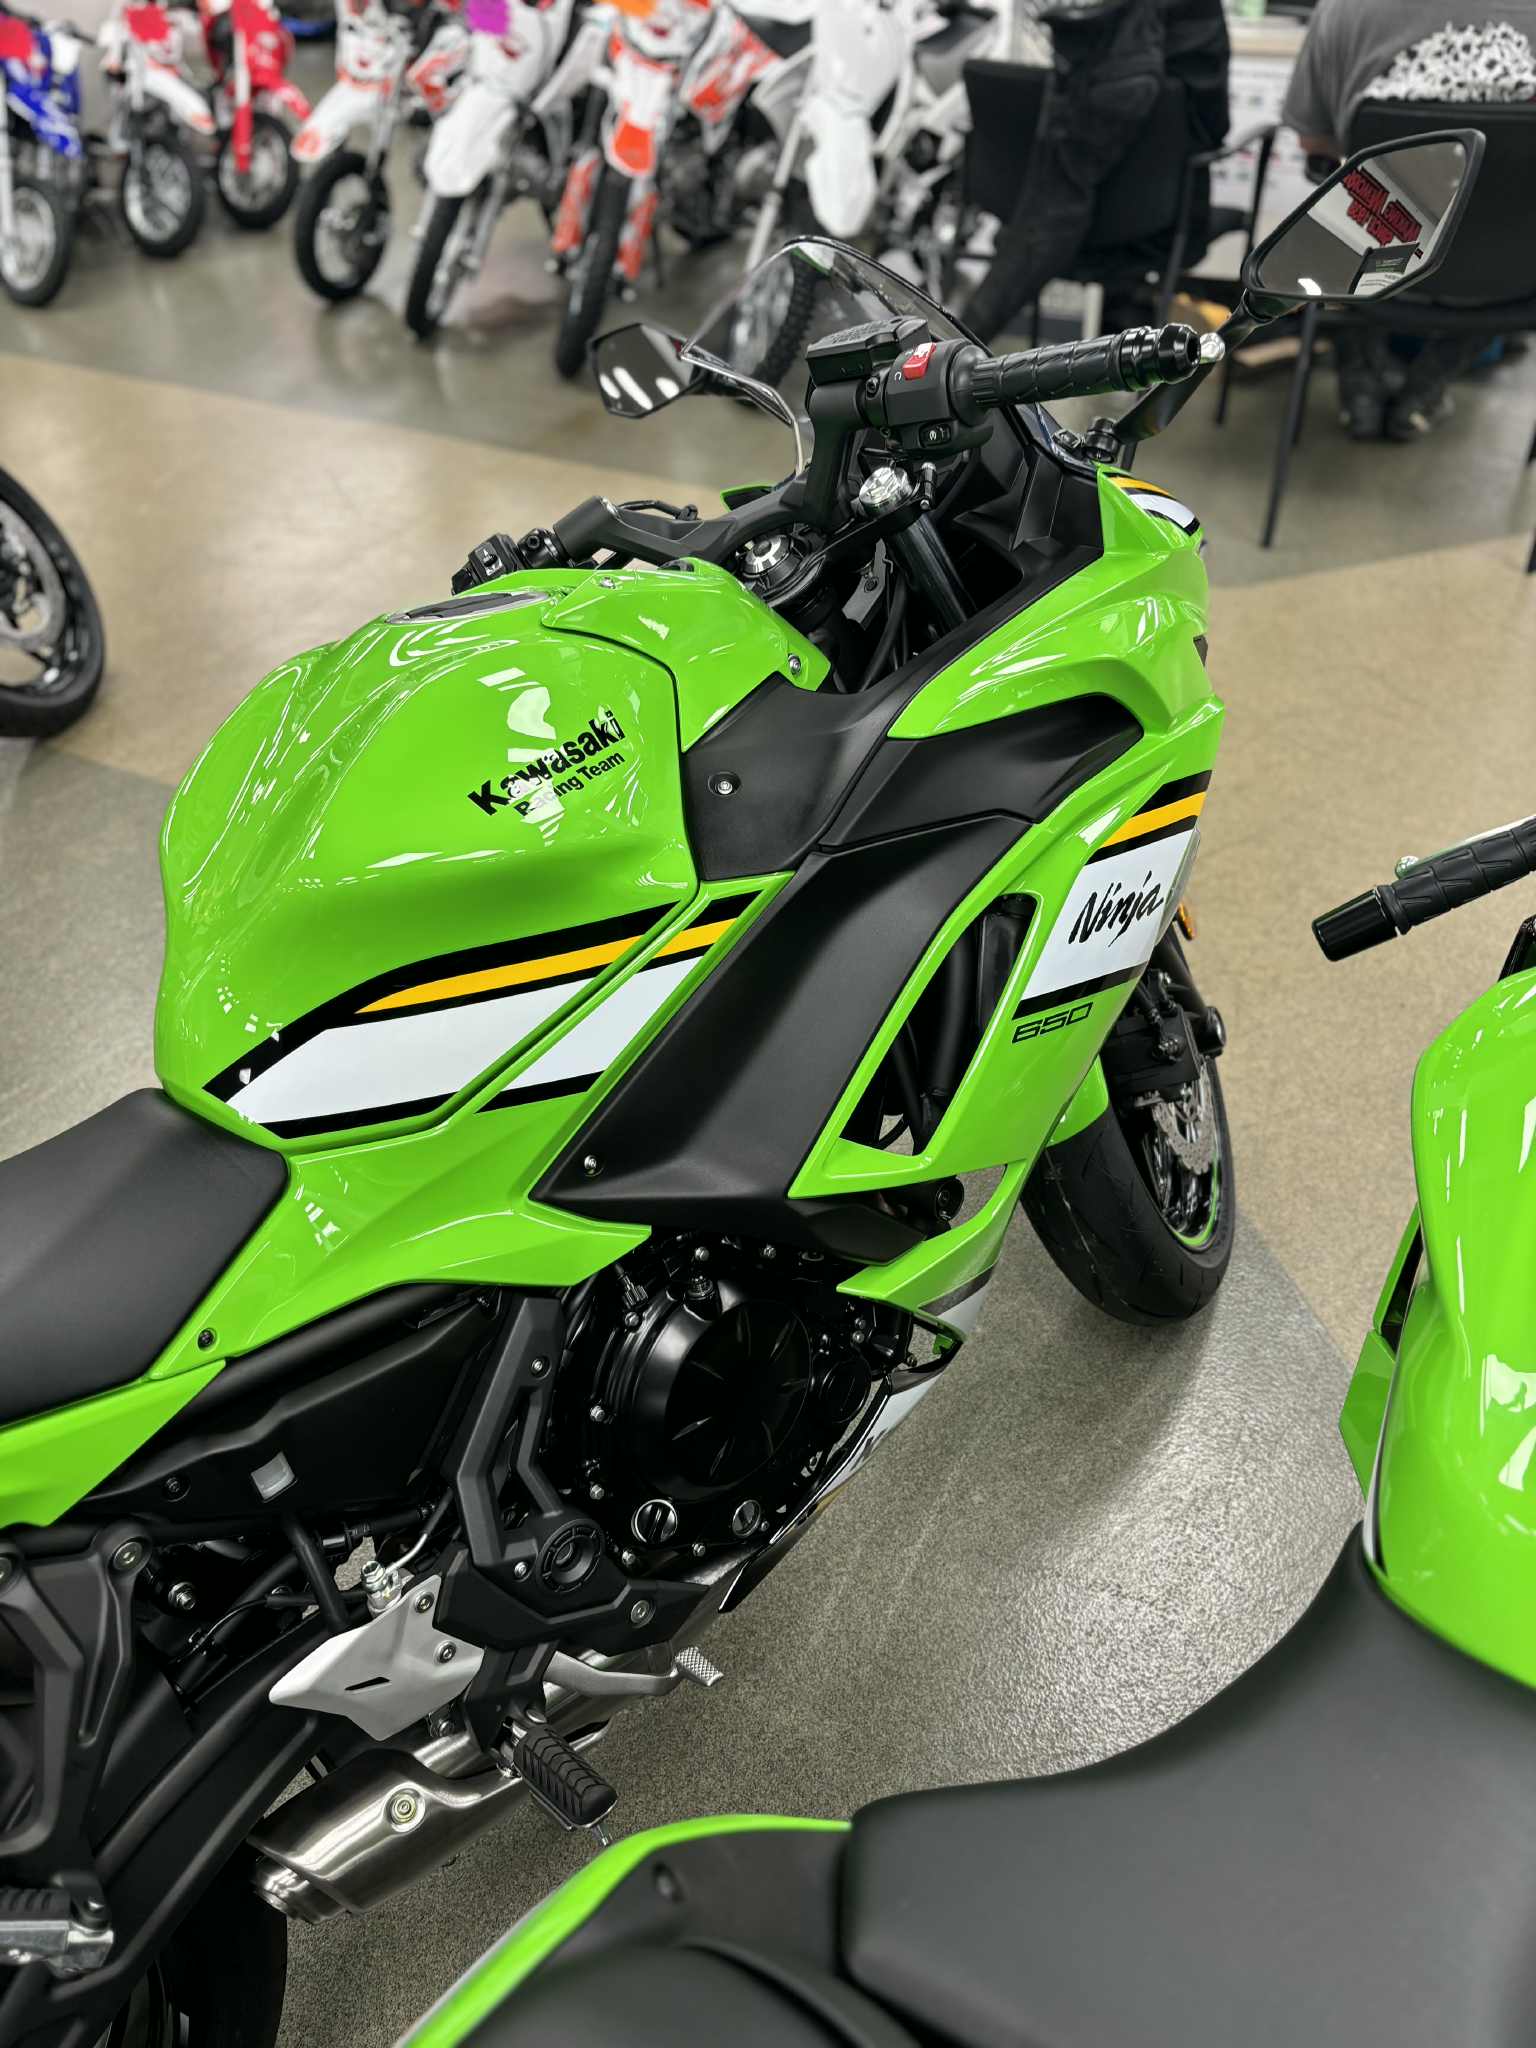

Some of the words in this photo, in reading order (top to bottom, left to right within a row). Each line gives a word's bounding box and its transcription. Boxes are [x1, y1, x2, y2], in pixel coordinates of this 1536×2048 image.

[467, 710, 626, 816] Kawasaki
[575, 752, 625, 780] Team
[1069, 870, 1165, 947] Ninja
[1012, 1003, 1093, 1044] 650
